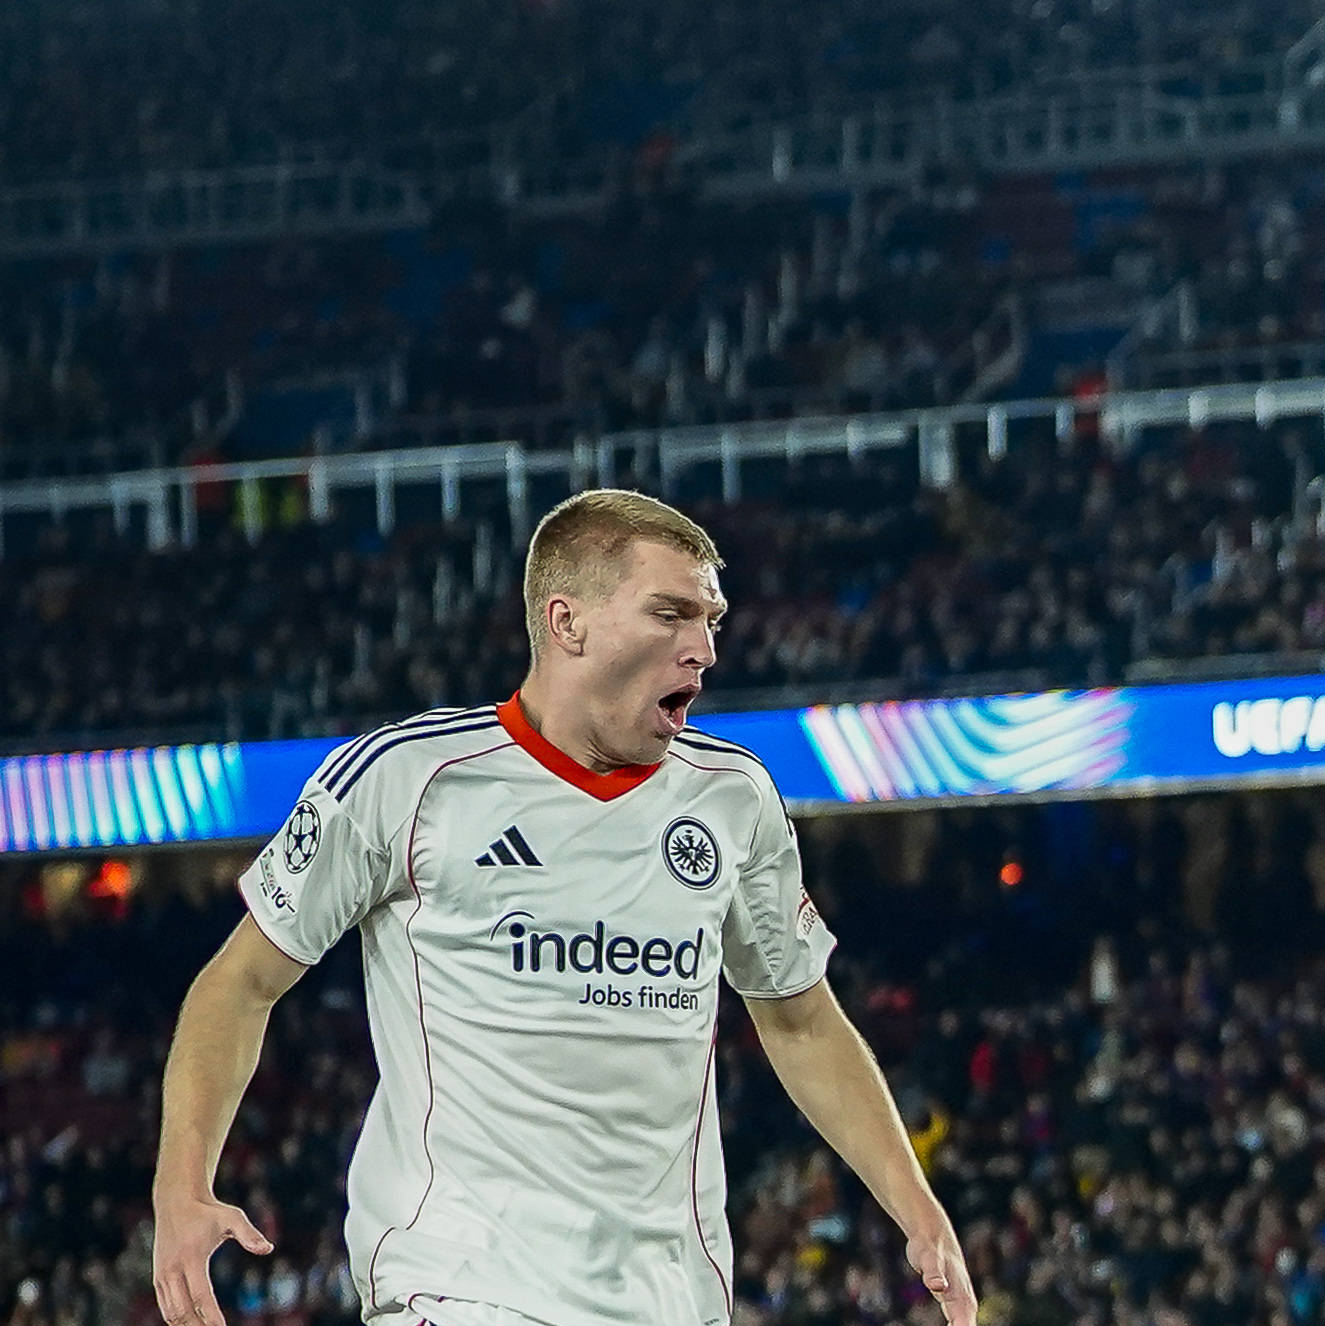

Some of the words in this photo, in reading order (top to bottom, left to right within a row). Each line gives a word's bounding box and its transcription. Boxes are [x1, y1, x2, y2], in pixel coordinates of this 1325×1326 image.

[508, 919, 704, 980] indeed
[578, 983, 633, 1007] Jobs
[637, 985, 699, 1010] finden
